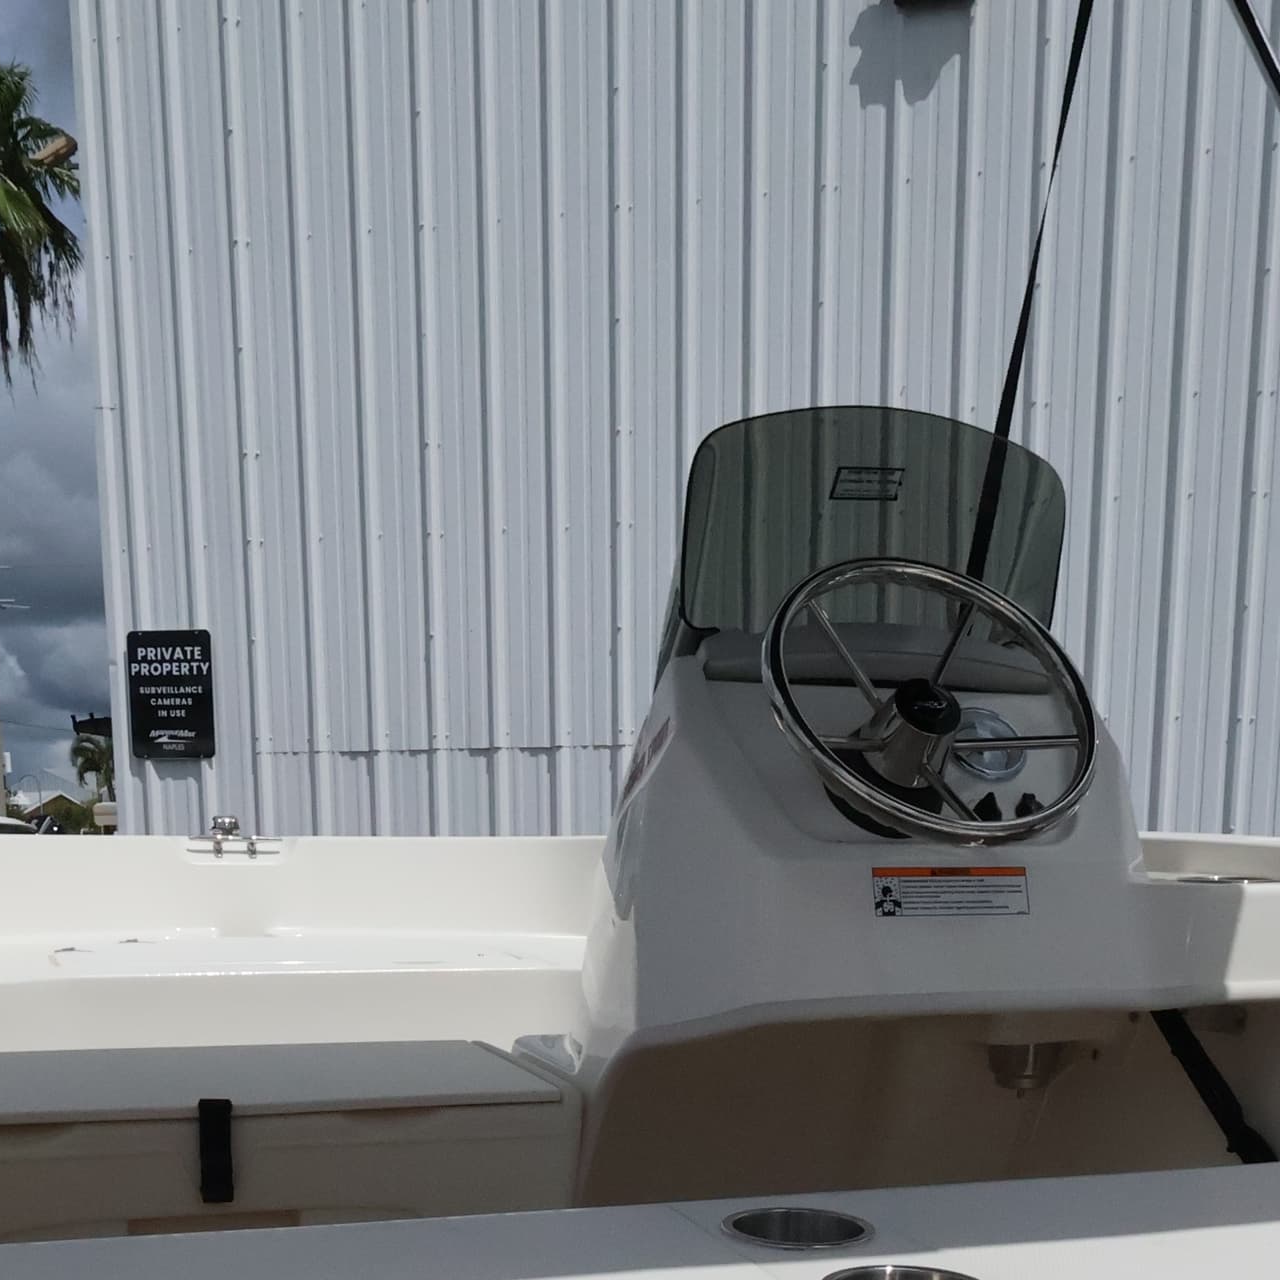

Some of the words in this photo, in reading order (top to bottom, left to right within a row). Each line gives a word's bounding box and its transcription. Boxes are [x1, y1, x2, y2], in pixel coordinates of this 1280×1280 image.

[137, 646, 202, 660] PRIVATE
[130, 662, 210, 676] PROPERTY
[139, 686, 203, 694] SURVEILLANCE
[150, 698, 193, 706] CAMERAS
[170, 709, 186, 717] USE
